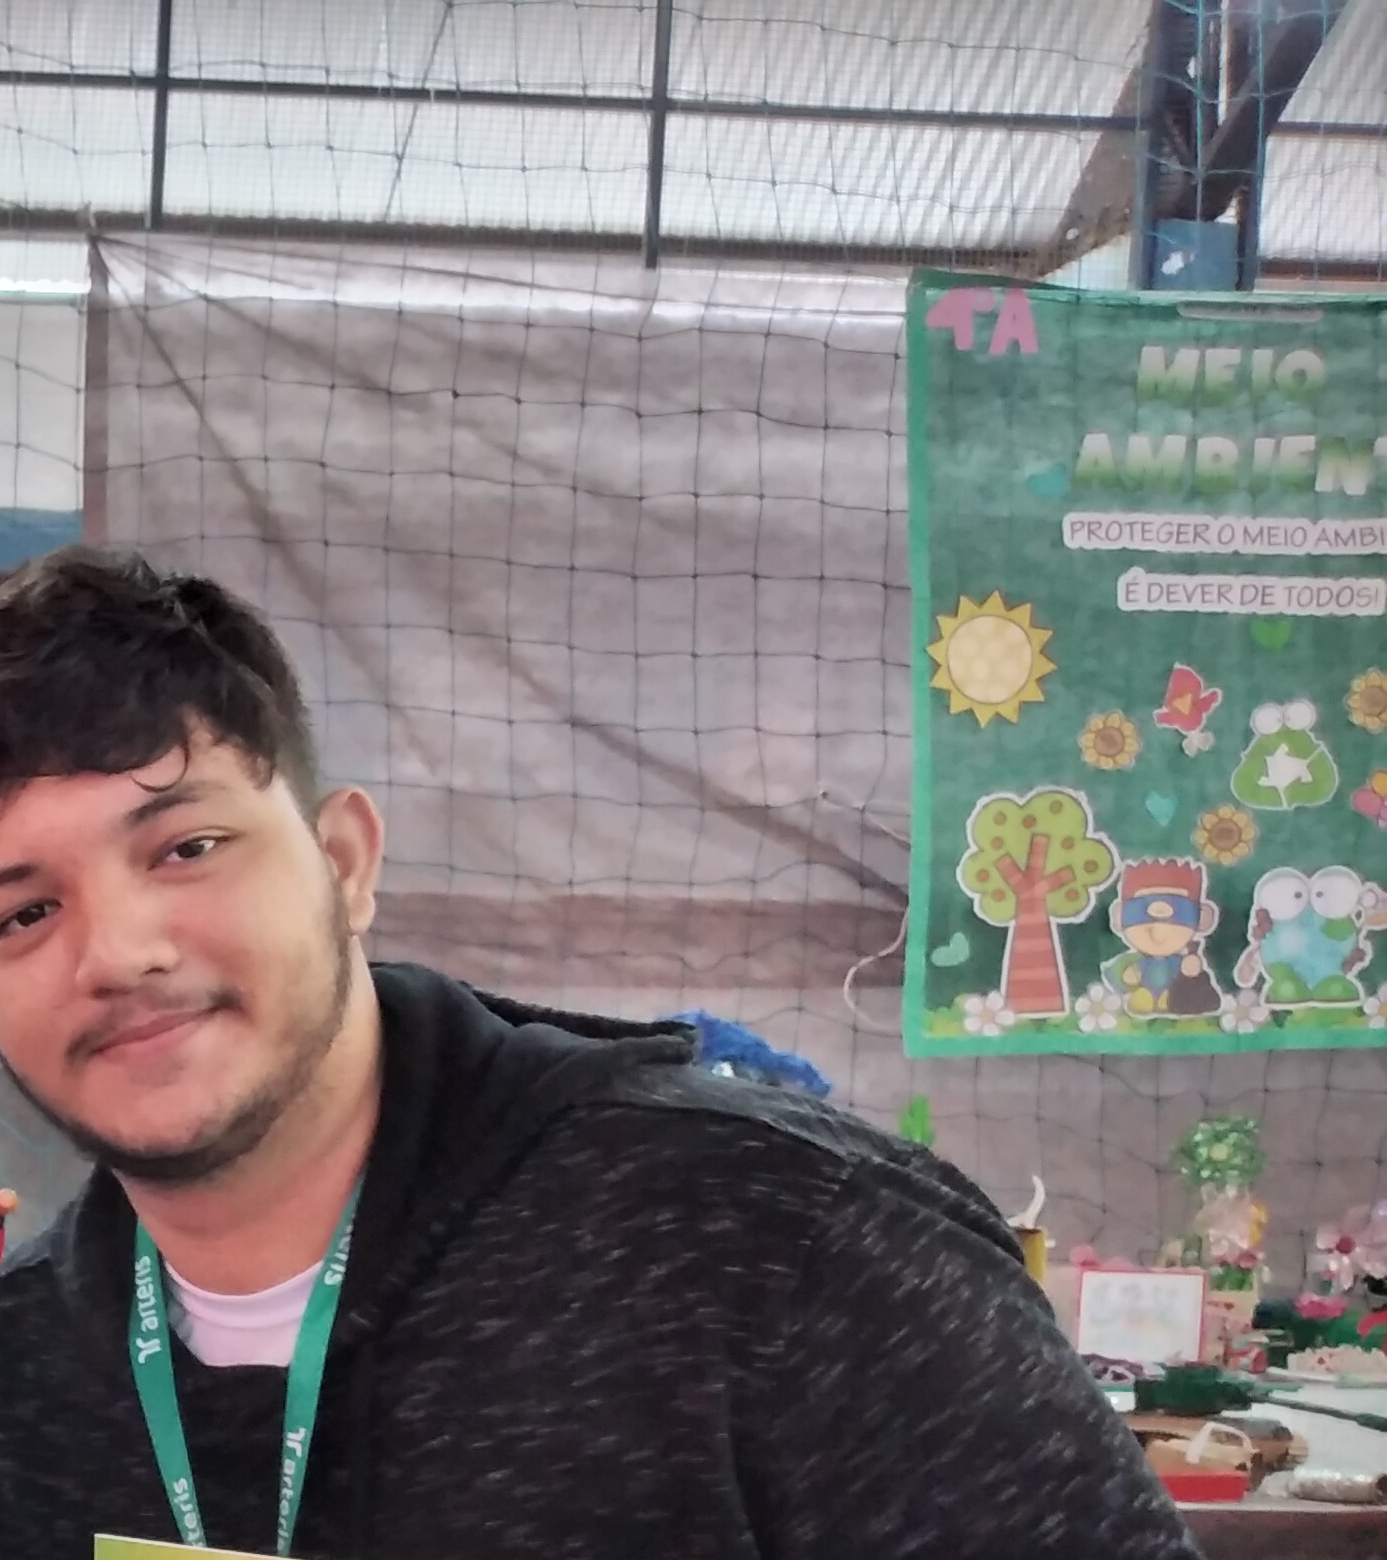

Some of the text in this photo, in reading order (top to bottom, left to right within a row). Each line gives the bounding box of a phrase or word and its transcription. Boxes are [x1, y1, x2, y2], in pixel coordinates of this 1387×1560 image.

[1136, 345, 1325, 406] MEIO
[1069, 520, 1211, 545] PROTEGER
[1218, 523, 1235, 545] O
[1243, 525, 1308, 547] MEIO
[1125, 576, 1140, 602] É
[1146, 582, 1233, 604] DEVER
[1240, 584, 1276, 605] DE
[135, 1255, 159, 1332] arteris
